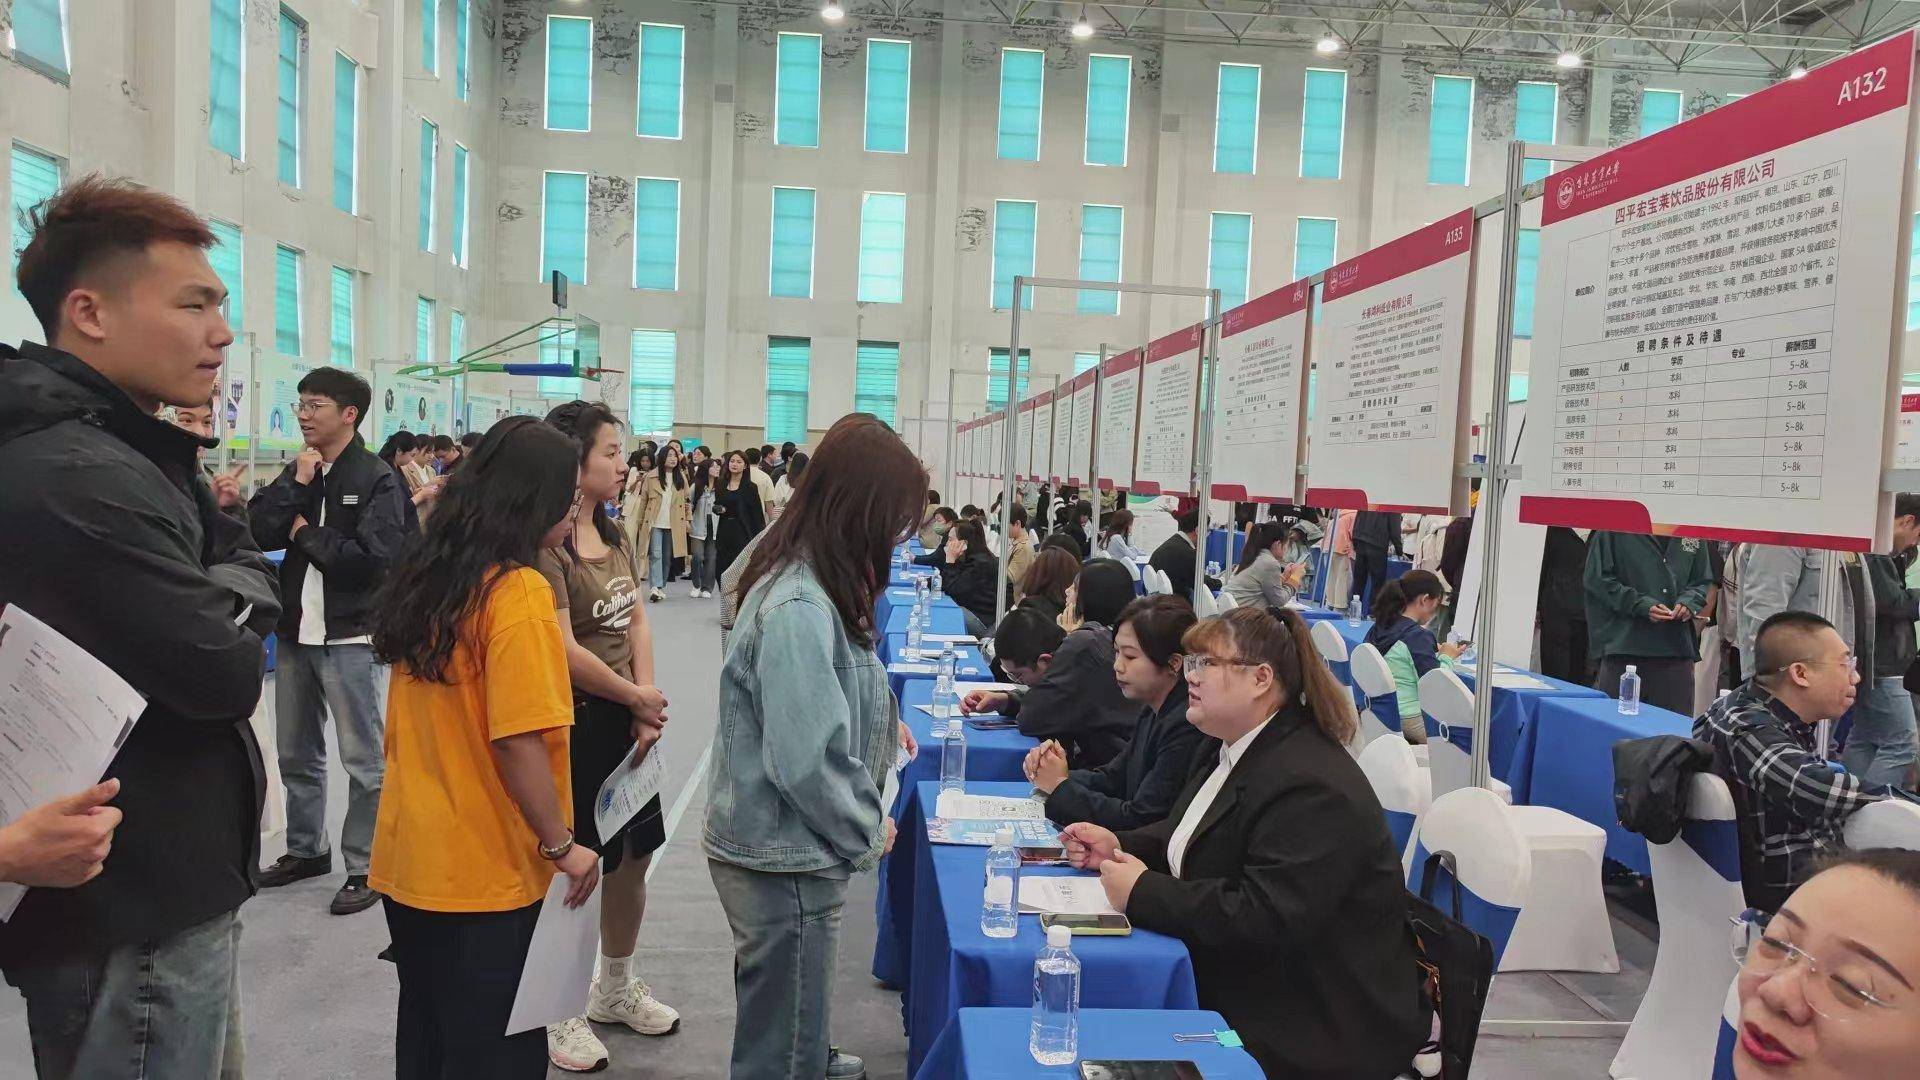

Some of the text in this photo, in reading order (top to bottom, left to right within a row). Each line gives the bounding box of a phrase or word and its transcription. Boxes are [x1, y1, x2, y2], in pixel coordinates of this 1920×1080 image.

[1837, 66, 1888, 106] A132
[1615, 158, 1776, 225] 四平宏宝莱饮品股份有限公司
[1444, 226, 1464, 246] A133
[1618, 362, 1630, 372] 人数
[1671, 356, 1684, 366] 学历
[1731, 348, 1746, 359] 专业
[1669, 373, 1682, 382] 本科
[1790, 359, 1809, 370] 5~8k
[1668, 390, 1681, 400] 本科
[1788, 379, 1808, 390] 5~8k
[1667, 408, 1680, 418] 本科
[1786, 401, 1806, 412] 5~8k
[1666, 426, 1679, 436] 本科
[1785, 422, 1804, 432] 5~8k
[1665, 444, 1678, 454] 本科
[1783, 442, 1803, 452] 5~8k
[1663, 461, 1677, 471] 本科
[1782, 462, 1801, 472] 5~8k
[1662, 480, 1675, 490] 本科
[1780, 483, 1800, 493] 5~8k
